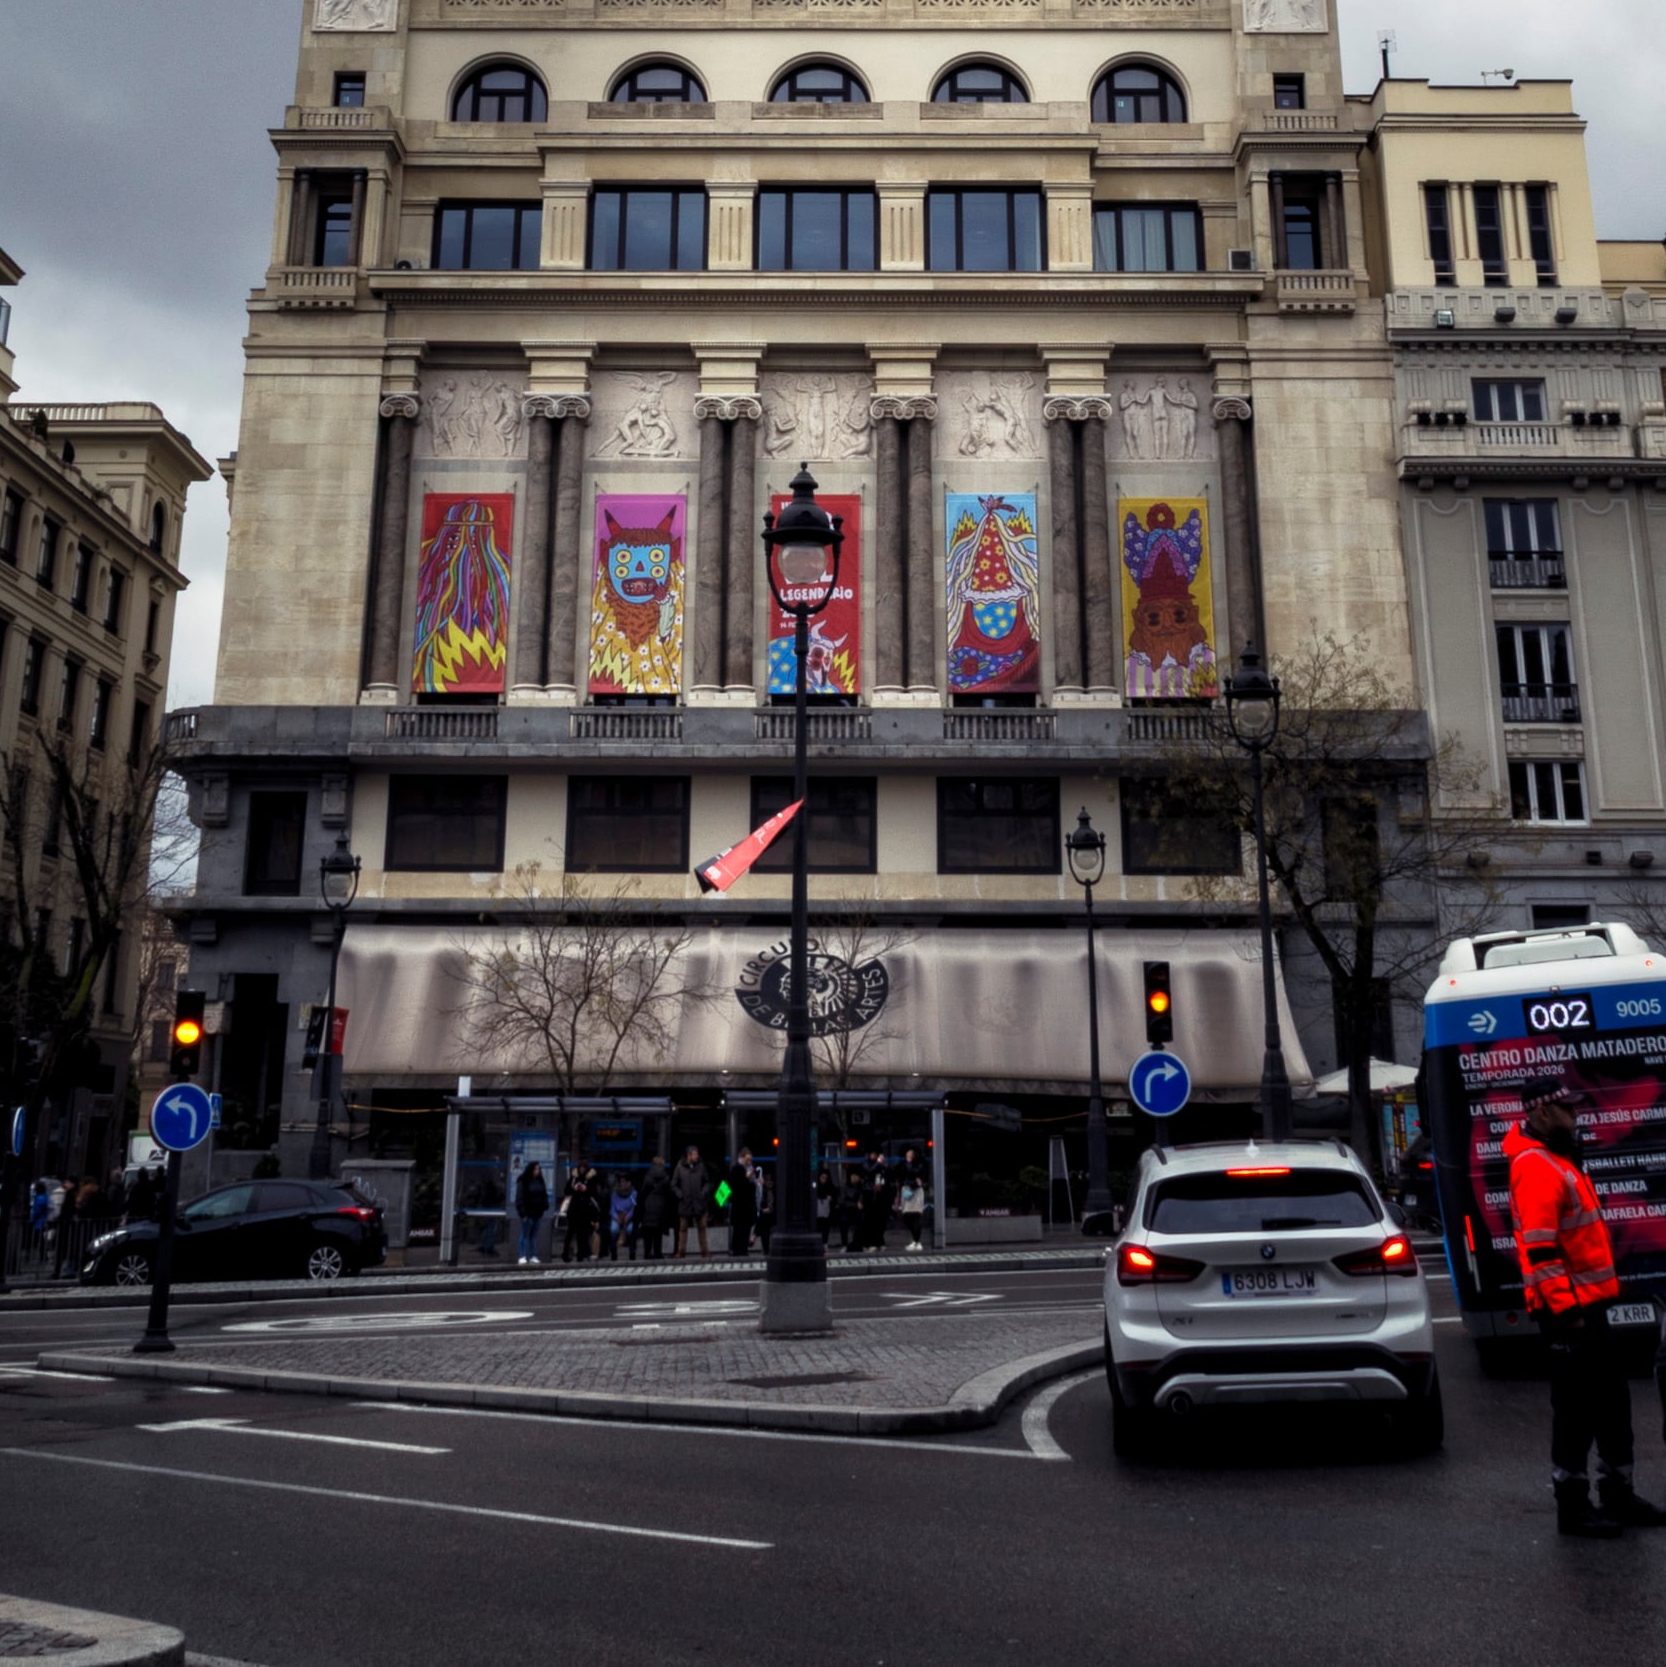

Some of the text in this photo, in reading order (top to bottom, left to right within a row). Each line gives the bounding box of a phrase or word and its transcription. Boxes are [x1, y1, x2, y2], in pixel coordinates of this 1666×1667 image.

[739, 938, 820, 987] CIRCUO
[742, 967, 885, 1034] DE BLAS ARTES
[1616, 998, 1662, 1018] 9005
[1529, 999, 1591, 1030] 002
[1458, 1048, 1521, 1070] CENTRO
[1523, 1043, 1579, 1064] DANZA
[1643, 1055, 1663, 1065] NAVE
[1461, 1063, 1565, 1084] TEMPORADA 2026
[1469, 1104, 1484, 1116] LA
[1598, 1109, 1631, 1124] JESÚS
[1595, 1180, 1648, 1195] DE DANZA
[1234, 1270, 1315, 1290] 6308 LJW
[1611, 1306, 1651, 1322] 2 KRR
